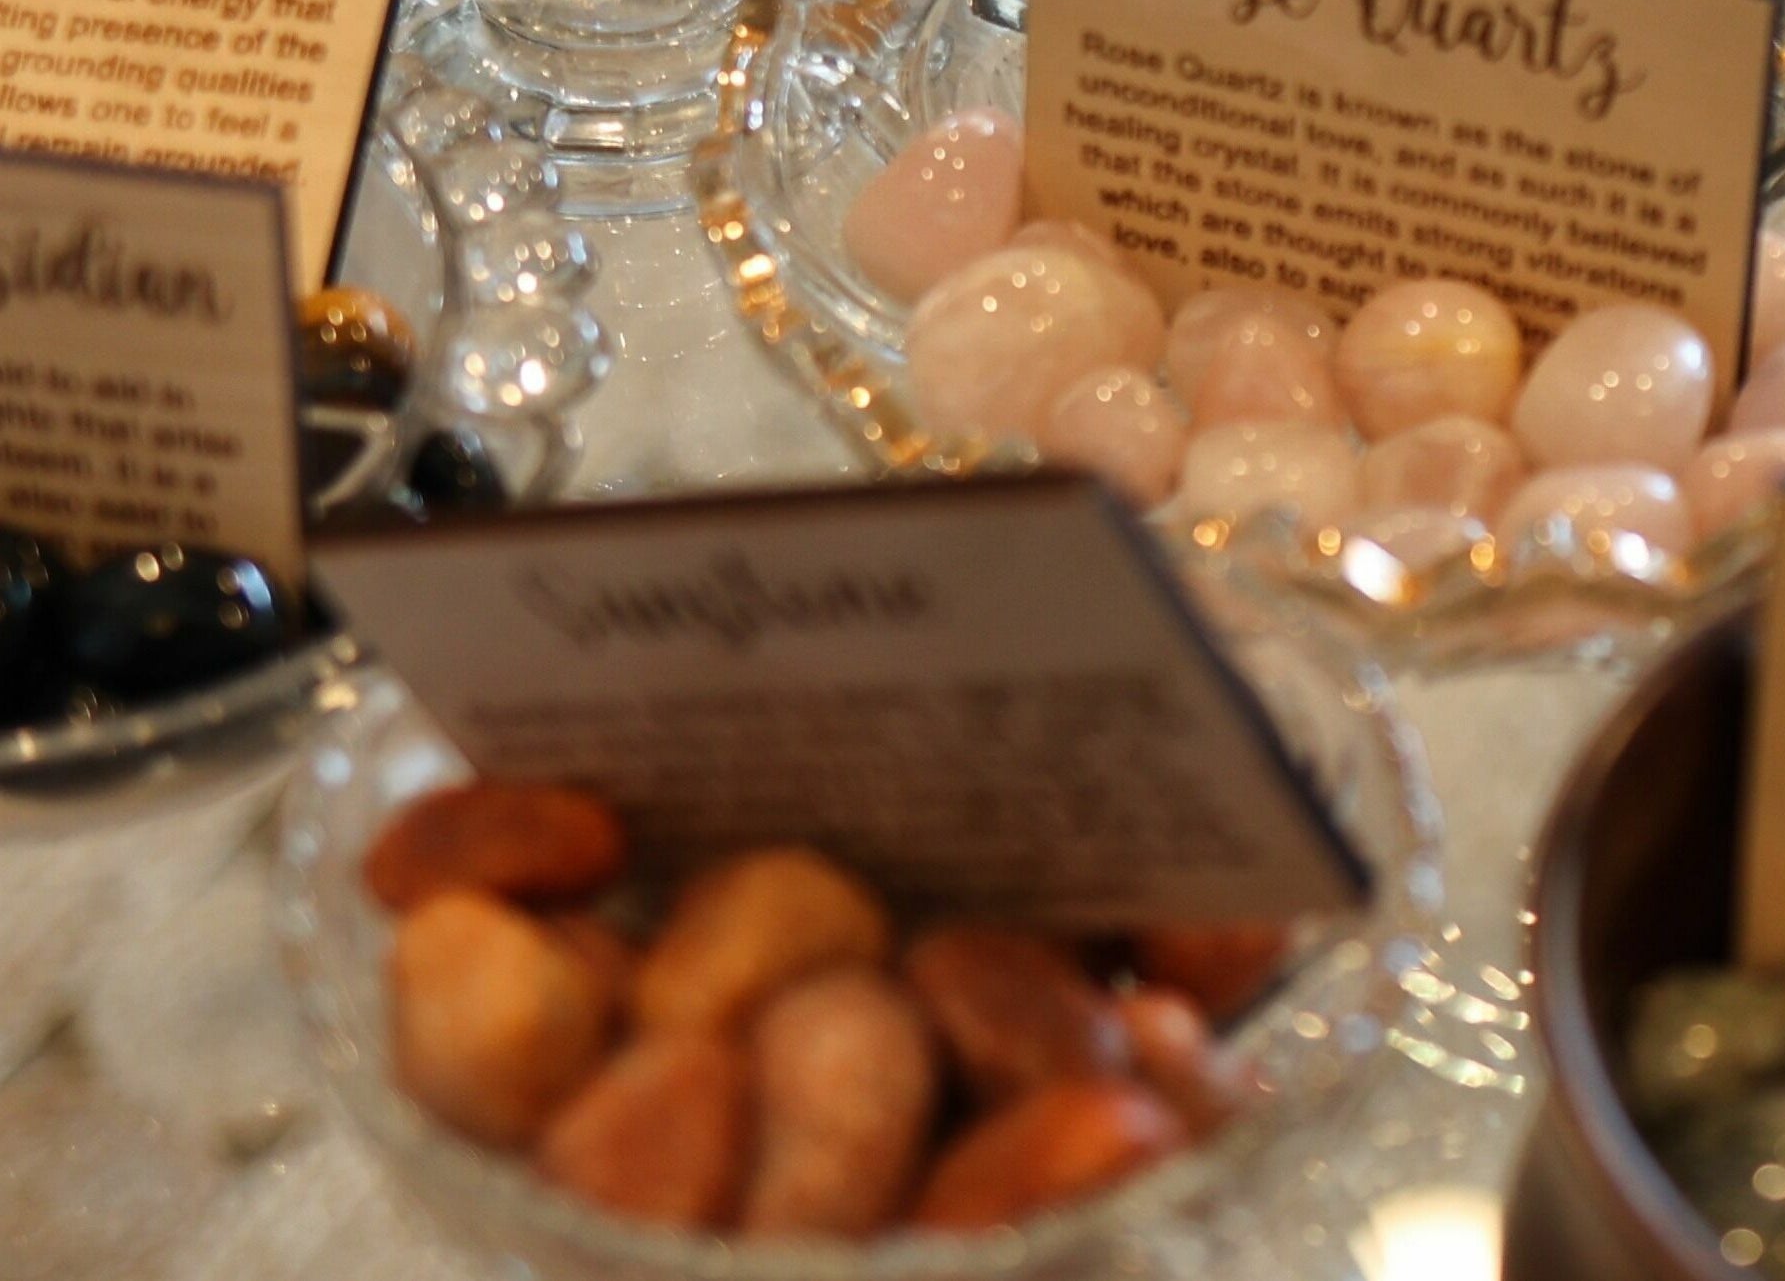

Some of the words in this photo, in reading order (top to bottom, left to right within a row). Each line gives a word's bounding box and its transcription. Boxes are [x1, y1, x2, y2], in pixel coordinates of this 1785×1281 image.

[67, 15, 222, 52] presence
[231, 30, 268, 56] of
[275, 32, 330, 64] the
[0, 49, 167, 94] grounding
[177, 66, 315, 104] qualities
[90, 99, 152, 128] one
[163, 102, 196, 130] to
[207, 105, 270, 140] feel
[278, 121, 300, 143] a
[1081, 144, 1139, 175] that
[1152, 161, 1199, 190] the
[1213, 179, 1300, 214] stone
[1312, 203, 1398, 238] emits
[1411, 225, 1512, 271] strong
[1526, 251, 1683, 306] vibrations
[1100, 189, 1187, 223] which
[1202, 213, 1250, 238] are
[1263, 222, 1383, 271] thought
[1395, 254, 1428, 278] to
[1113, 223, 1186, 263] love,
[1200, 248, 1264, 278] also
[1277, 261, 1305, 289] to
